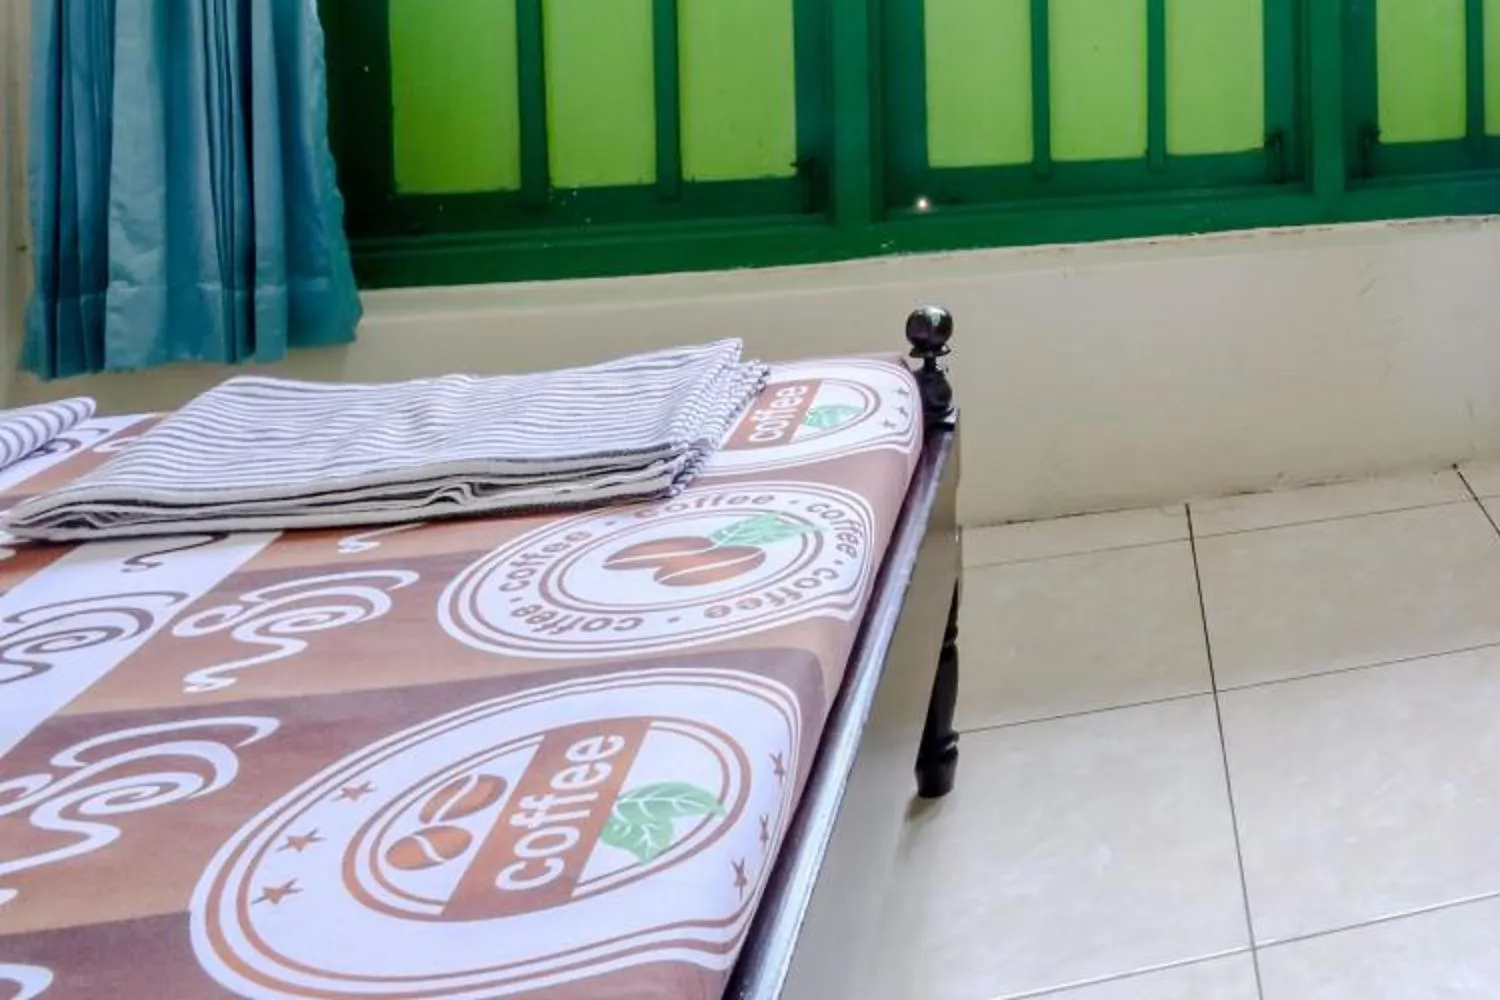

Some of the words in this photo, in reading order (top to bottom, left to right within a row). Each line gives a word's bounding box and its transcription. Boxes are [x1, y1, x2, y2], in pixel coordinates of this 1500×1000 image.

[748, 386, 809, 443] coffee
[632, 491, 776, 519] coffee
[806, 502, 863, 559] coffee
[499, 531, 592, 592] coffee
[511, 604, 644, 635] coffee
[703, 567, 839, 619] coffee
[495, 735, 626, 891] coffee
